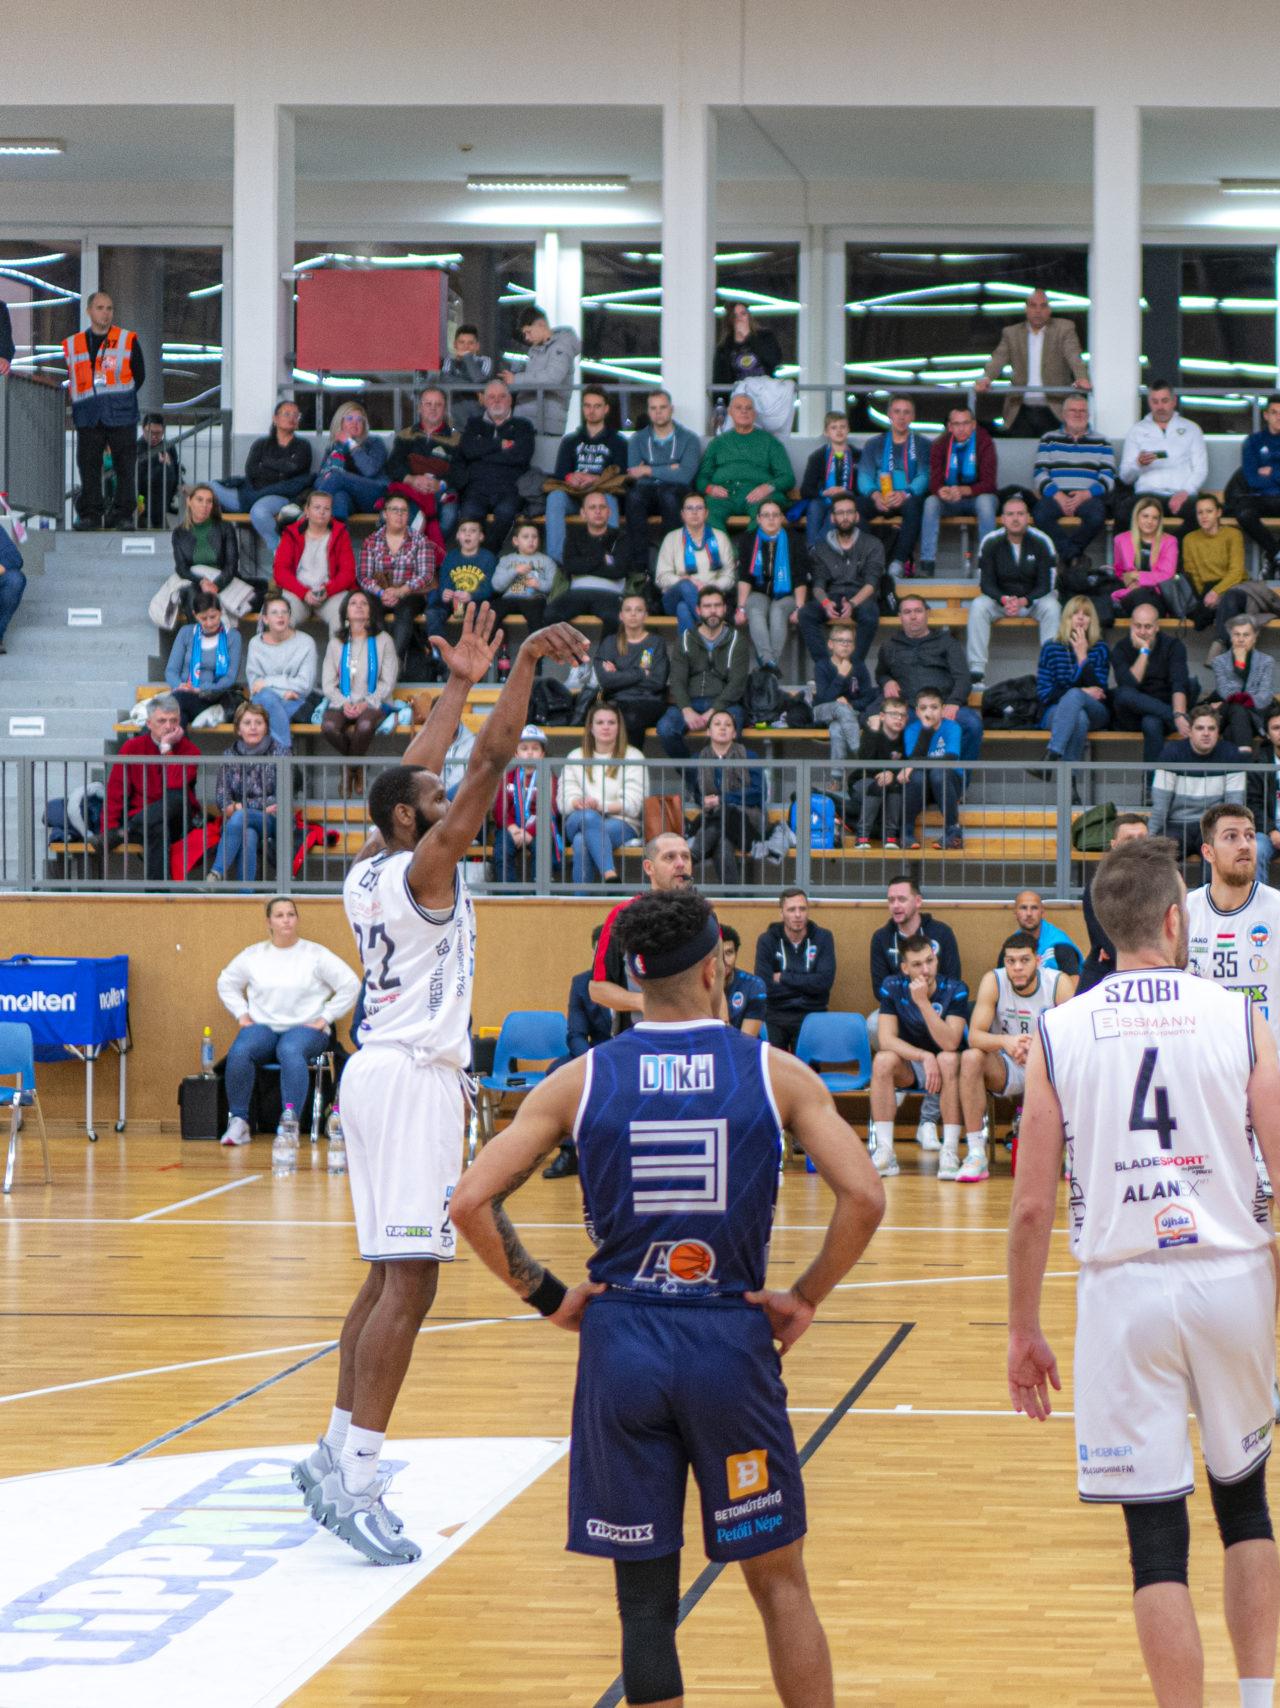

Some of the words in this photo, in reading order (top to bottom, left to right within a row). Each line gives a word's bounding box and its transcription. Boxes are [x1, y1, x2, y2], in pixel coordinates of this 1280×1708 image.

[1213, 951, 1238, 978] 35
[1105, 977, 1180, 1003] SZOBI
[1129, 1047, 1177, 1149] 4
[629, 1118, 728, 1215] 3
[1114, 1155, 1205, 1172] BLADESPORT
[737, 1460, 759, 1489] B
[755, 1512, 783, 1534] Népe
